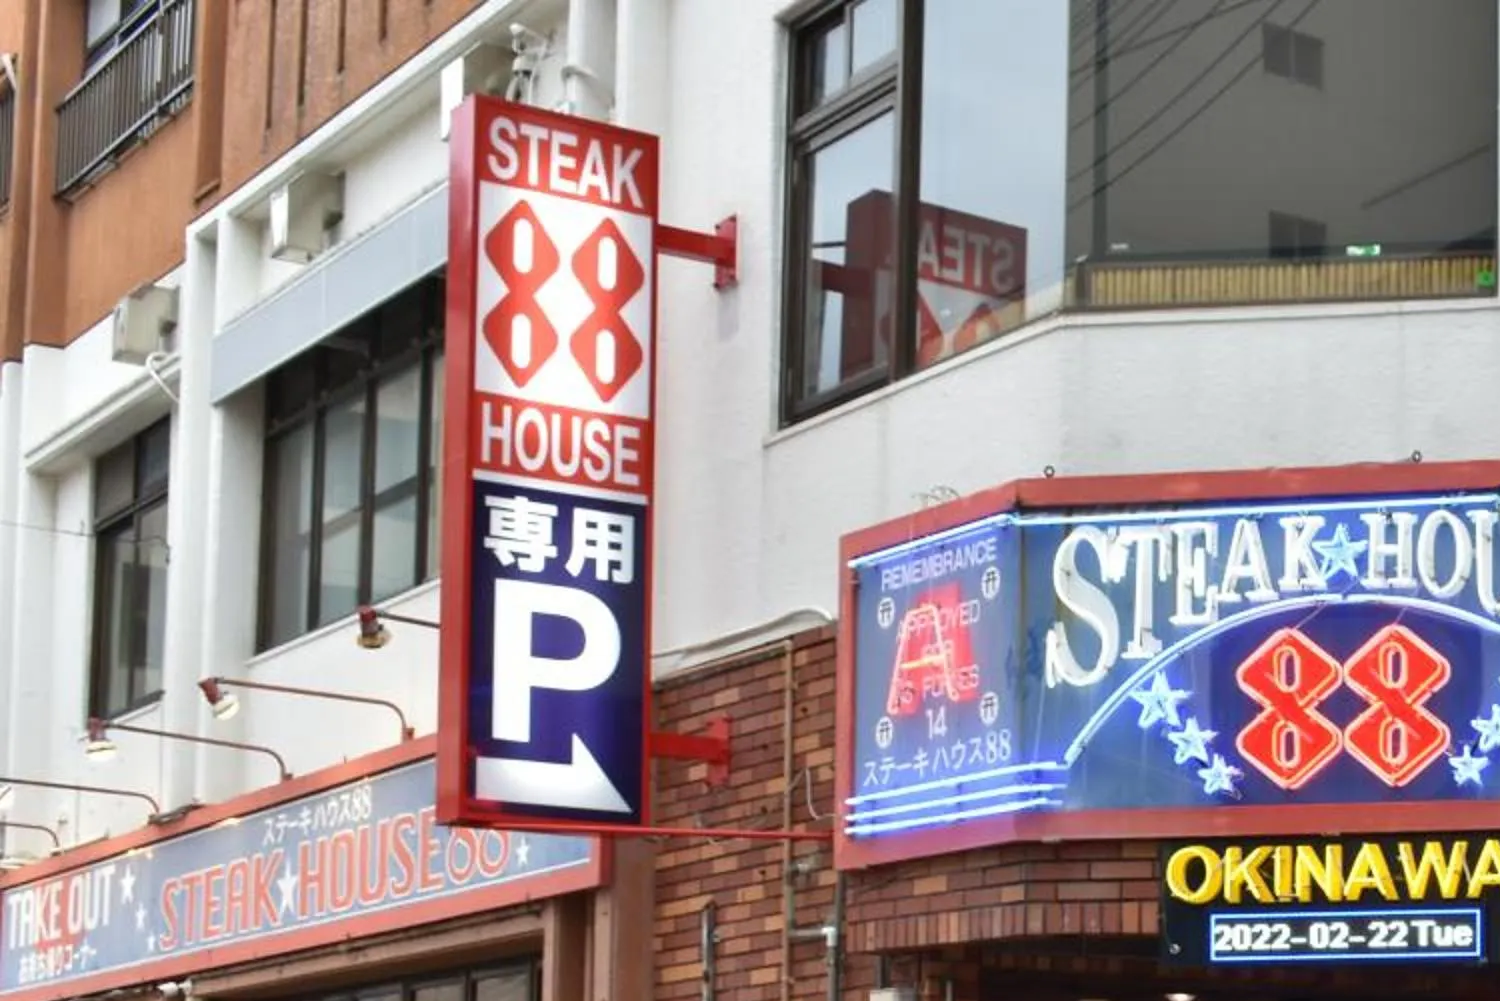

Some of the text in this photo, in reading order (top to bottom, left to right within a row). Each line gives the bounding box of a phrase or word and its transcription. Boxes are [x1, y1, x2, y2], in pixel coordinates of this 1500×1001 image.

[487, 116, 643, 209] STEAK
[483, 199, 645, 402] 88
[481, 401, 641, 486] HOUSE
[483, 494, 636, 584] 専用
[881, 537, 998, 592] REMEMBRANCE
[896, 599, 981, 643] APPROVED
[1046, 513, 1326, 689] STEAK
[492, 577, 621, 741] P
[922, 664, 980, 700] FORCES
[925, 705, 948, 740] 14
[1236, 624, 1452, 789] 88
[863, 729, 1012, 787] ステーキハウス88
[263, 785, 372, 847] ステーキハウス88
[8, 863, 116, 950] TAKE OUT
[159, 846, 285, 951] STEAK
[300, 806, 445, 919] HOUSE
[1214, 919, 1474, 951] 2022-02-22 Tue
